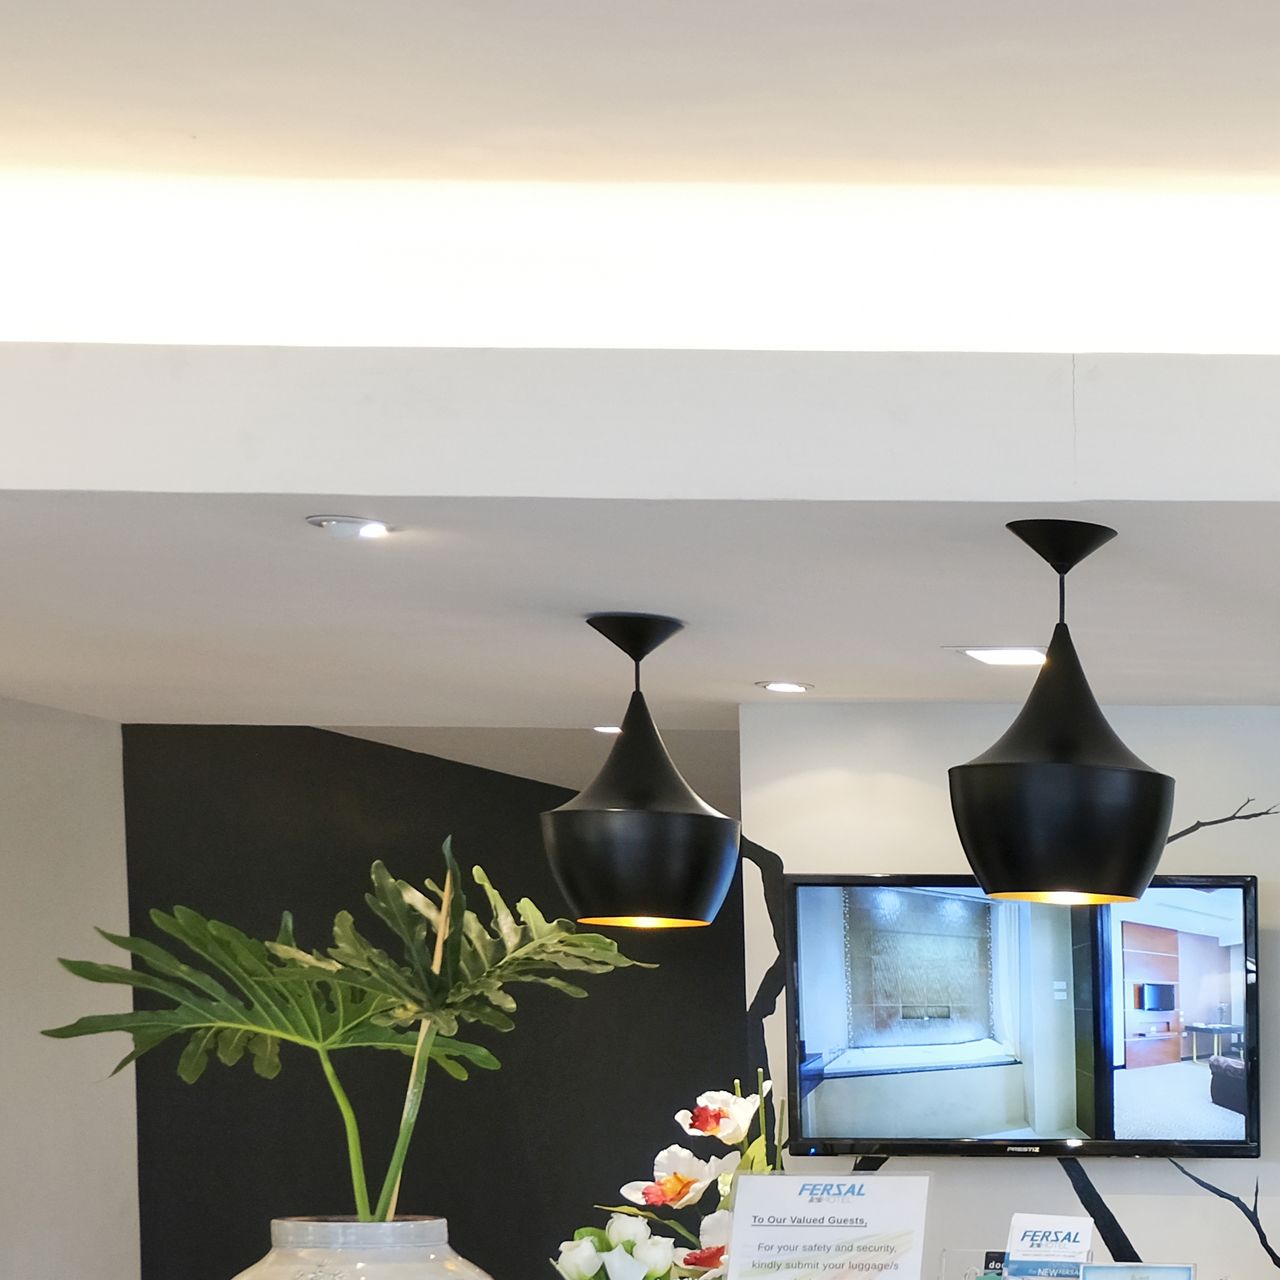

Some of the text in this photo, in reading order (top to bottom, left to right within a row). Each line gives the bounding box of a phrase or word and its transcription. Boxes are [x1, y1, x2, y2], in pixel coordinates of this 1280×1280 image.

[798, 1183, 866, 1196] FERSAL
[752, 1215, 868, 1227] To Our Valued Guests,
[1020, 1230, 1080, 1243] FERSAL
[757, 1243, 897, 1254] For your safety and security,
[752, 1261, 899, 1271] kindly submit your luggage/s
[1037, 1268, 1058, 1277] NEW
